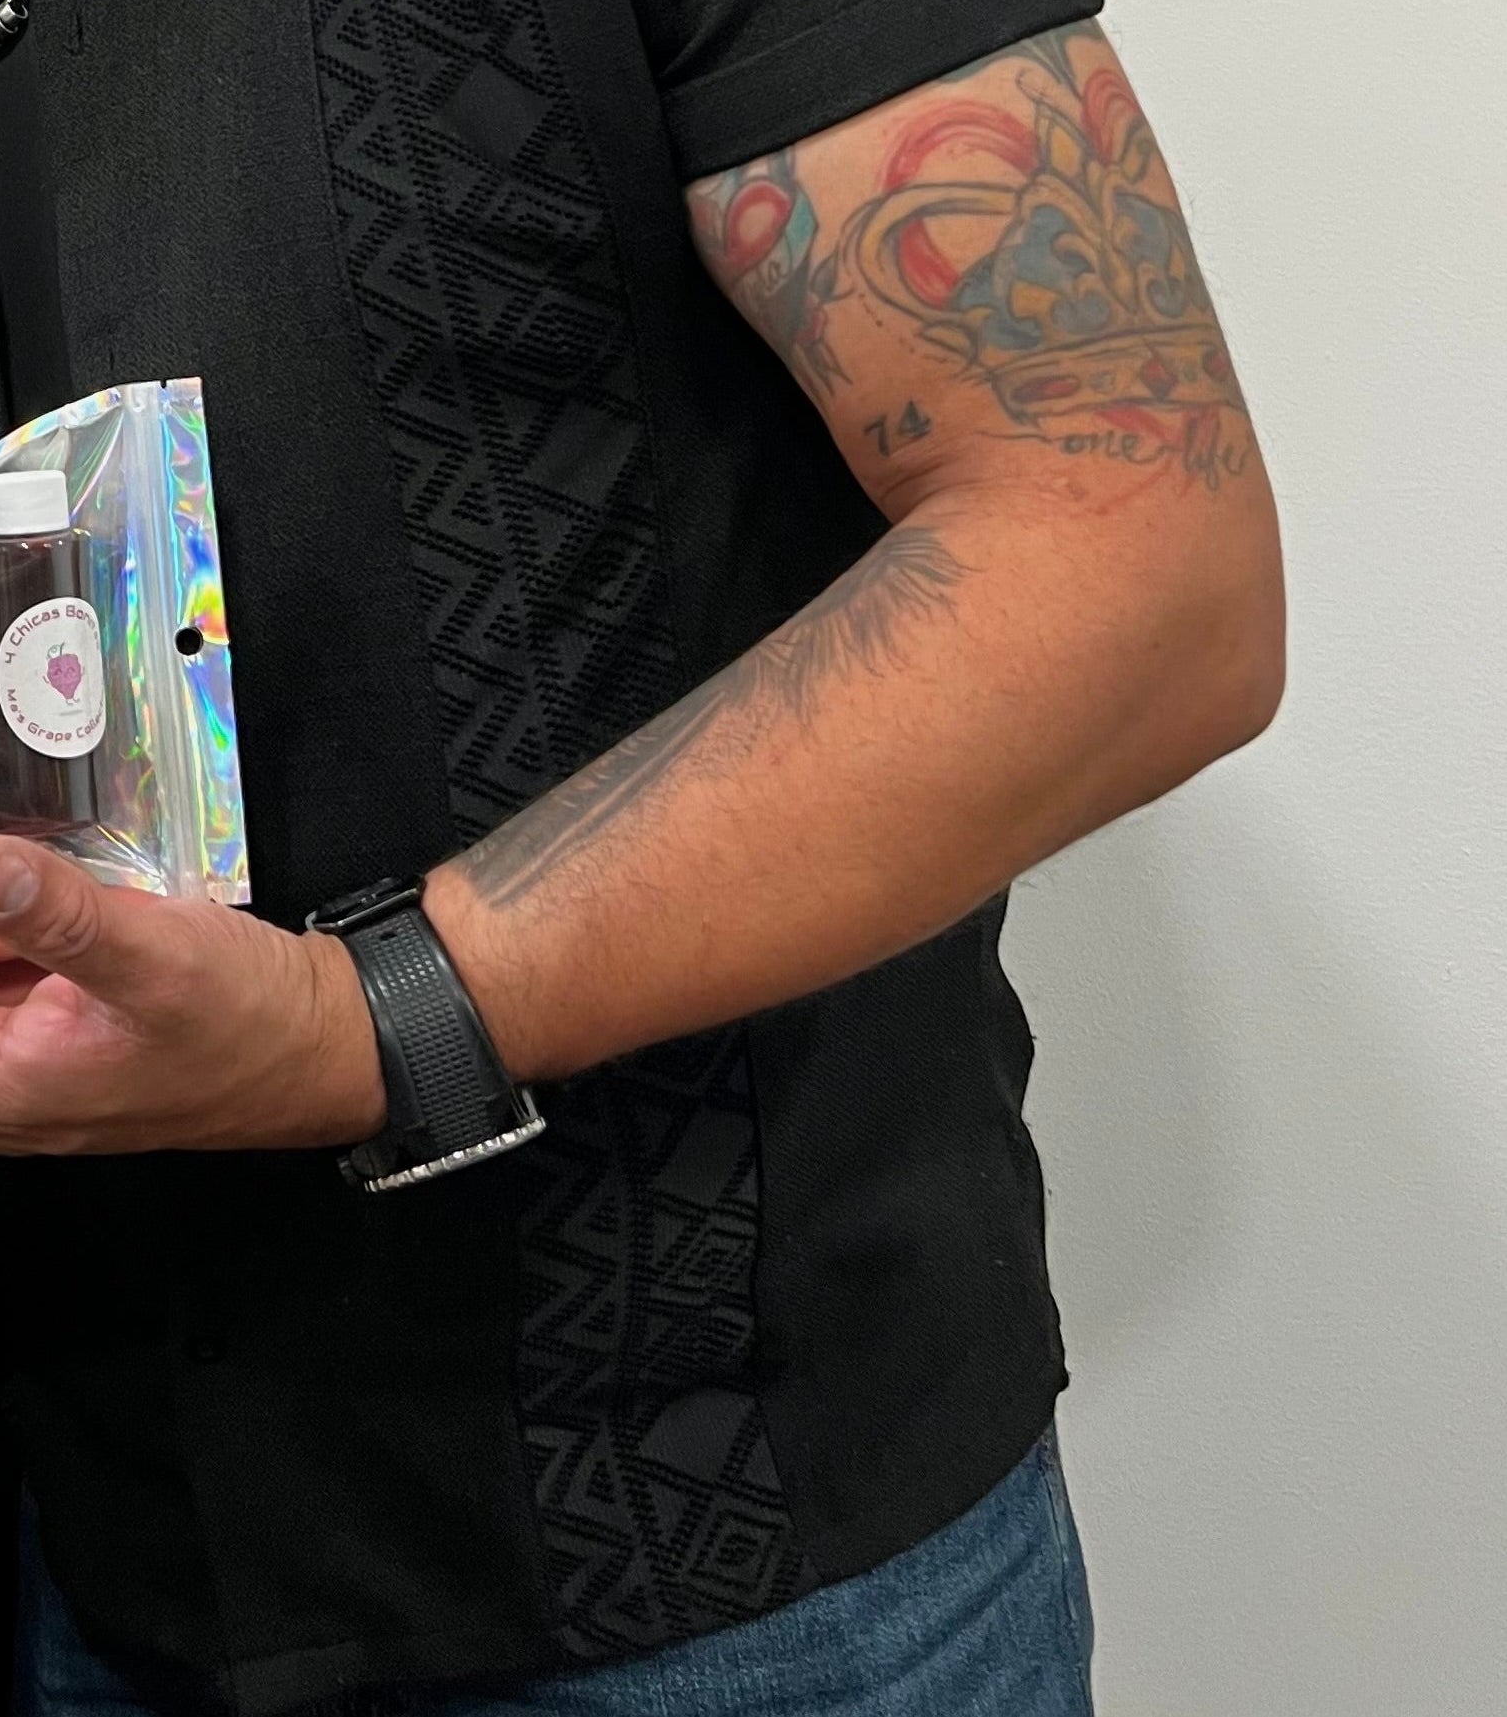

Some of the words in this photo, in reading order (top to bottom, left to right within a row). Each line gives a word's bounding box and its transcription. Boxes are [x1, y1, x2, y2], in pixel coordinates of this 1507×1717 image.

[863, 399, 932, 457] 74
[9, 608, 60, 647] Chicas
[4, 651, 17, 664] 4
[27, 722, 72, 742] Grape
